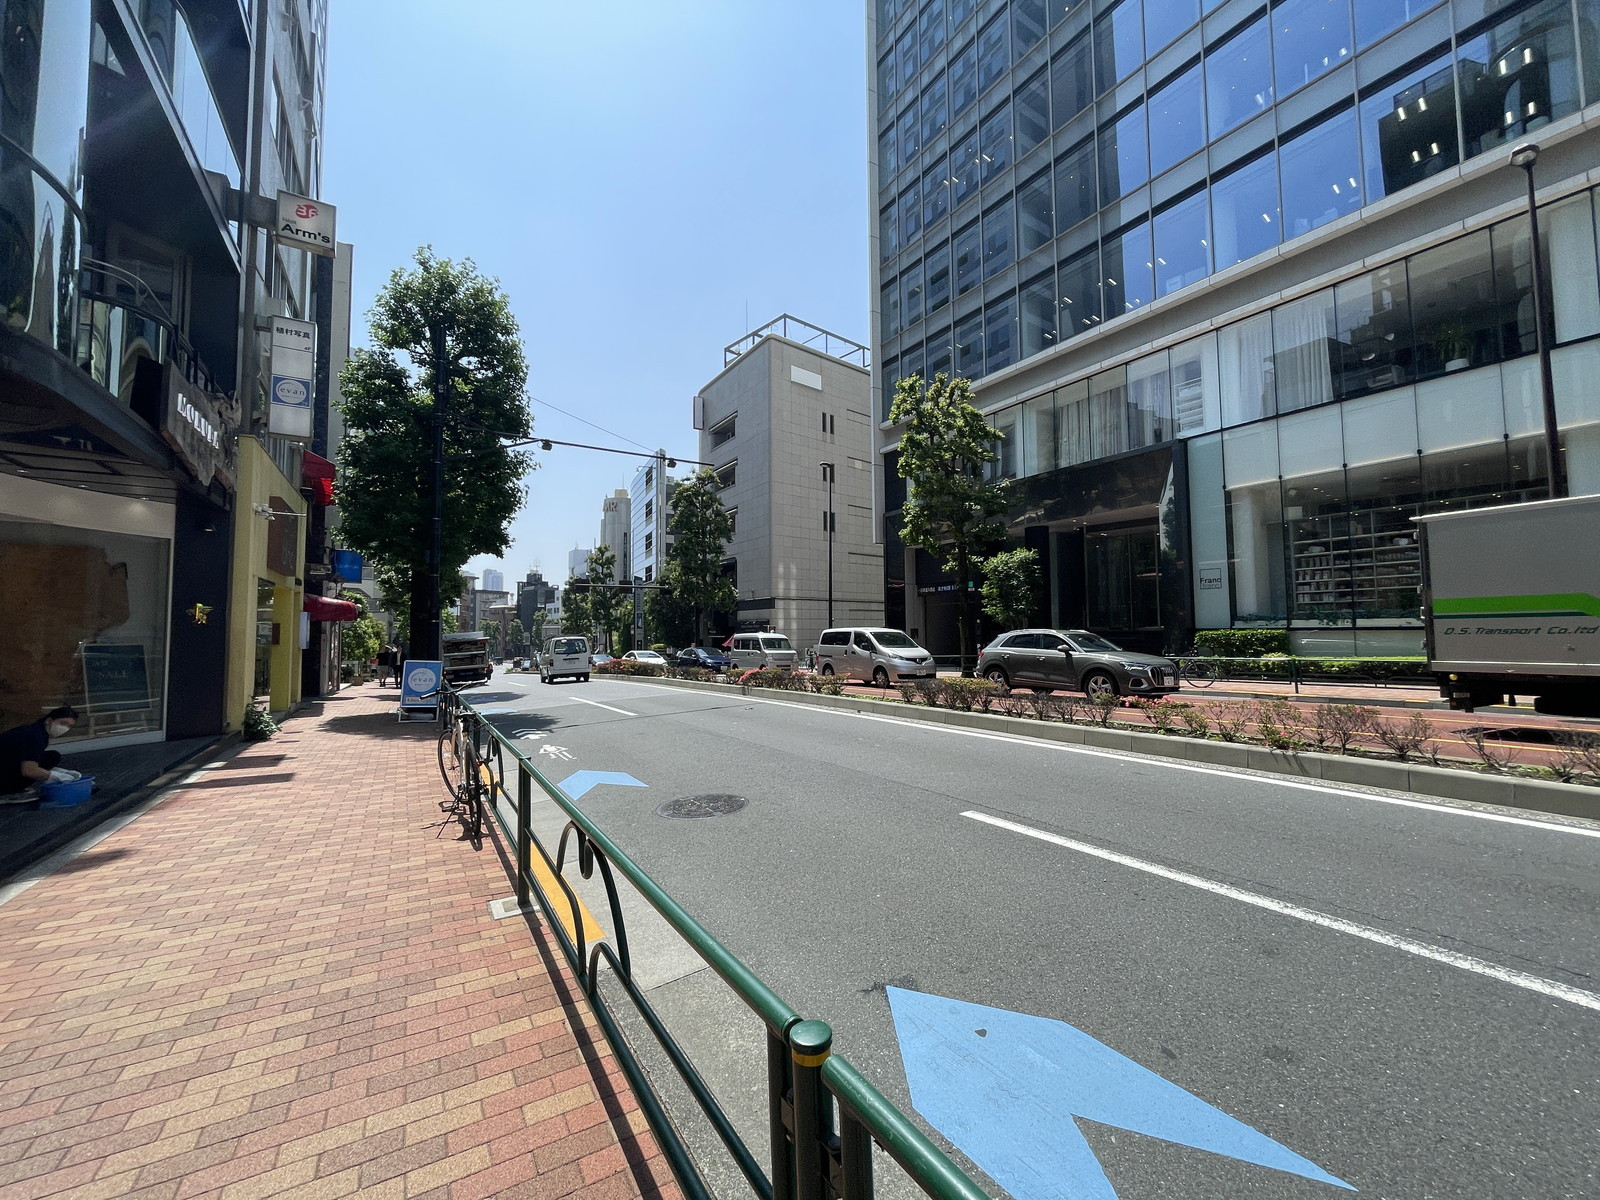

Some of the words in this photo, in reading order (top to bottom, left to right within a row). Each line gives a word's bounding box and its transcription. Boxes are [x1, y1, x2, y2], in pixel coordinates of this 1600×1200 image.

[281, 223, 331, 244] Arm's
[275, 326, 311, 340] 植村写真
[280, 387, 305, 396] evan
[1474, 626, 1541, 636] Transport
